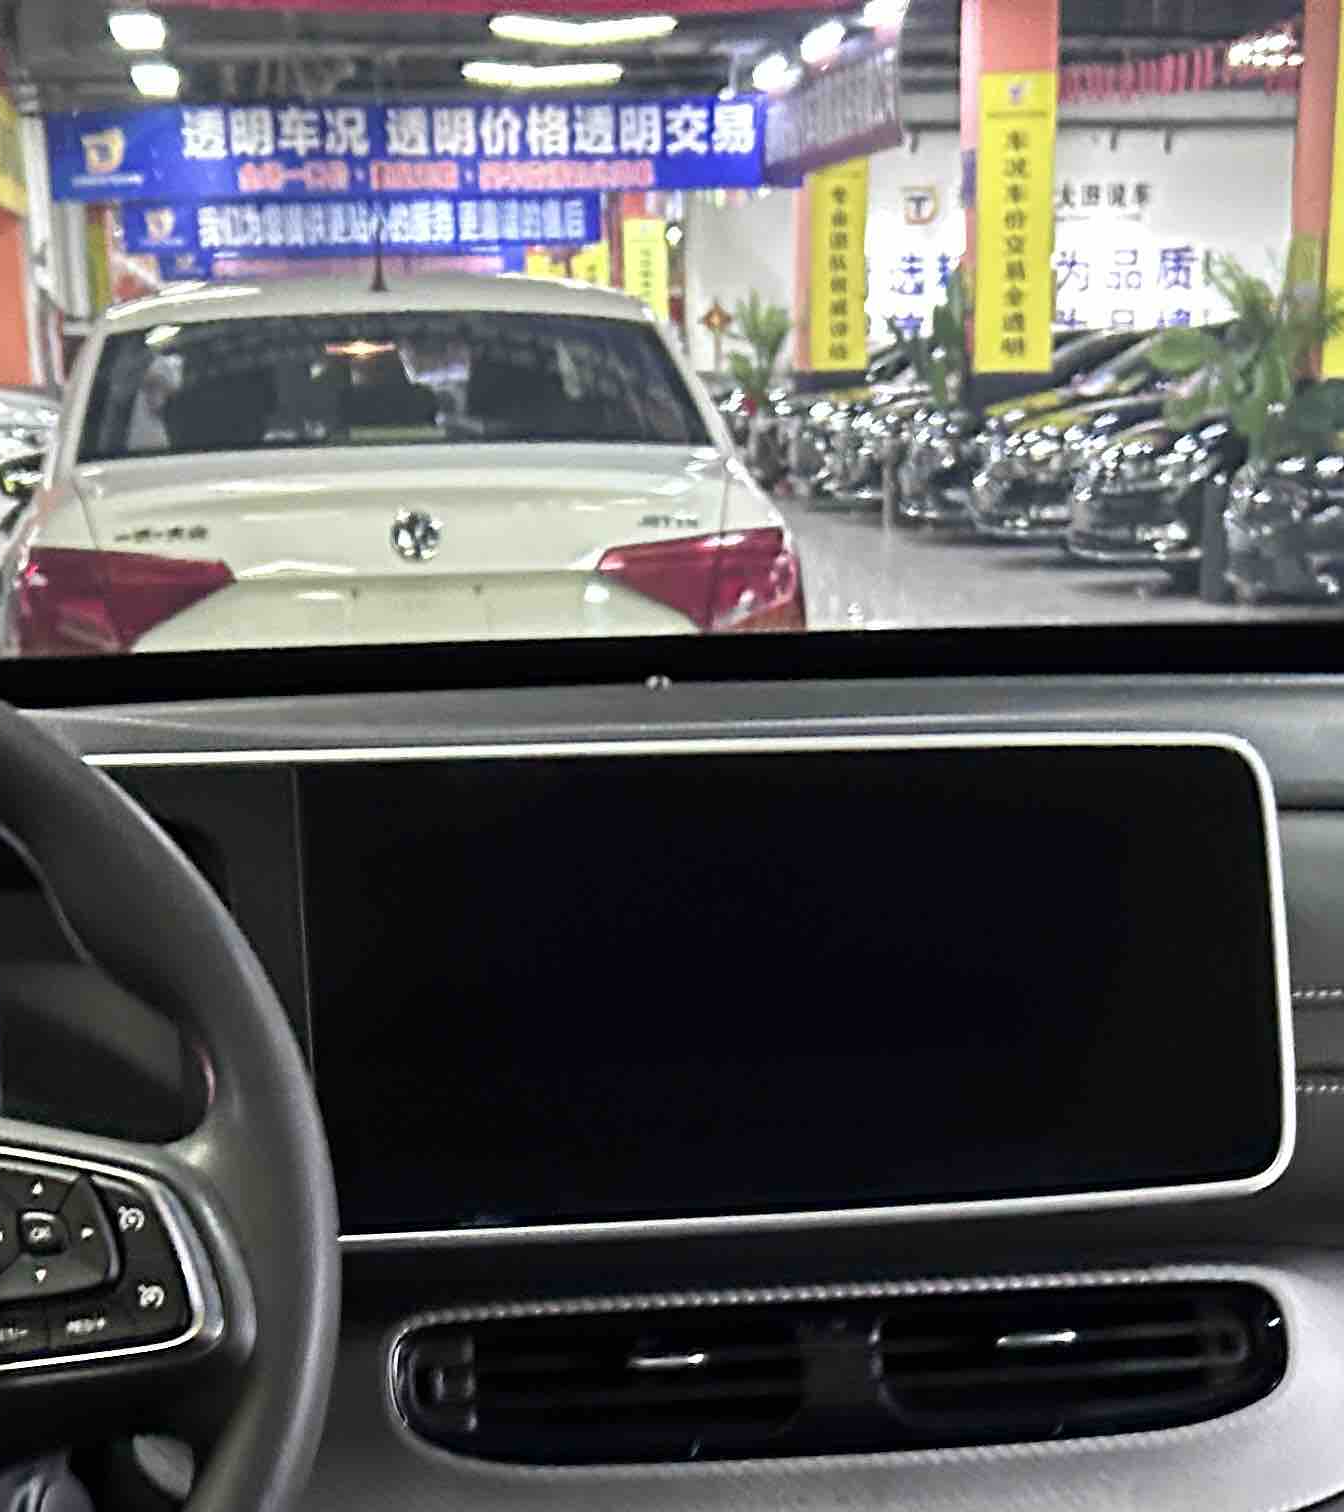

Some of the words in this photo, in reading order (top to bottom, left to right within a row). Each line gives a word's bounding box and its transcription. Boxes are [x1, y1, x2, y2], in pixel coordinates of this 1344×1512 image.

[181, 106, 369, 159] 透明车况
[385, 102, 755, 156] 透明价格透明交易
[1001, 130, 1027, 358] 车况车价交易全透明
